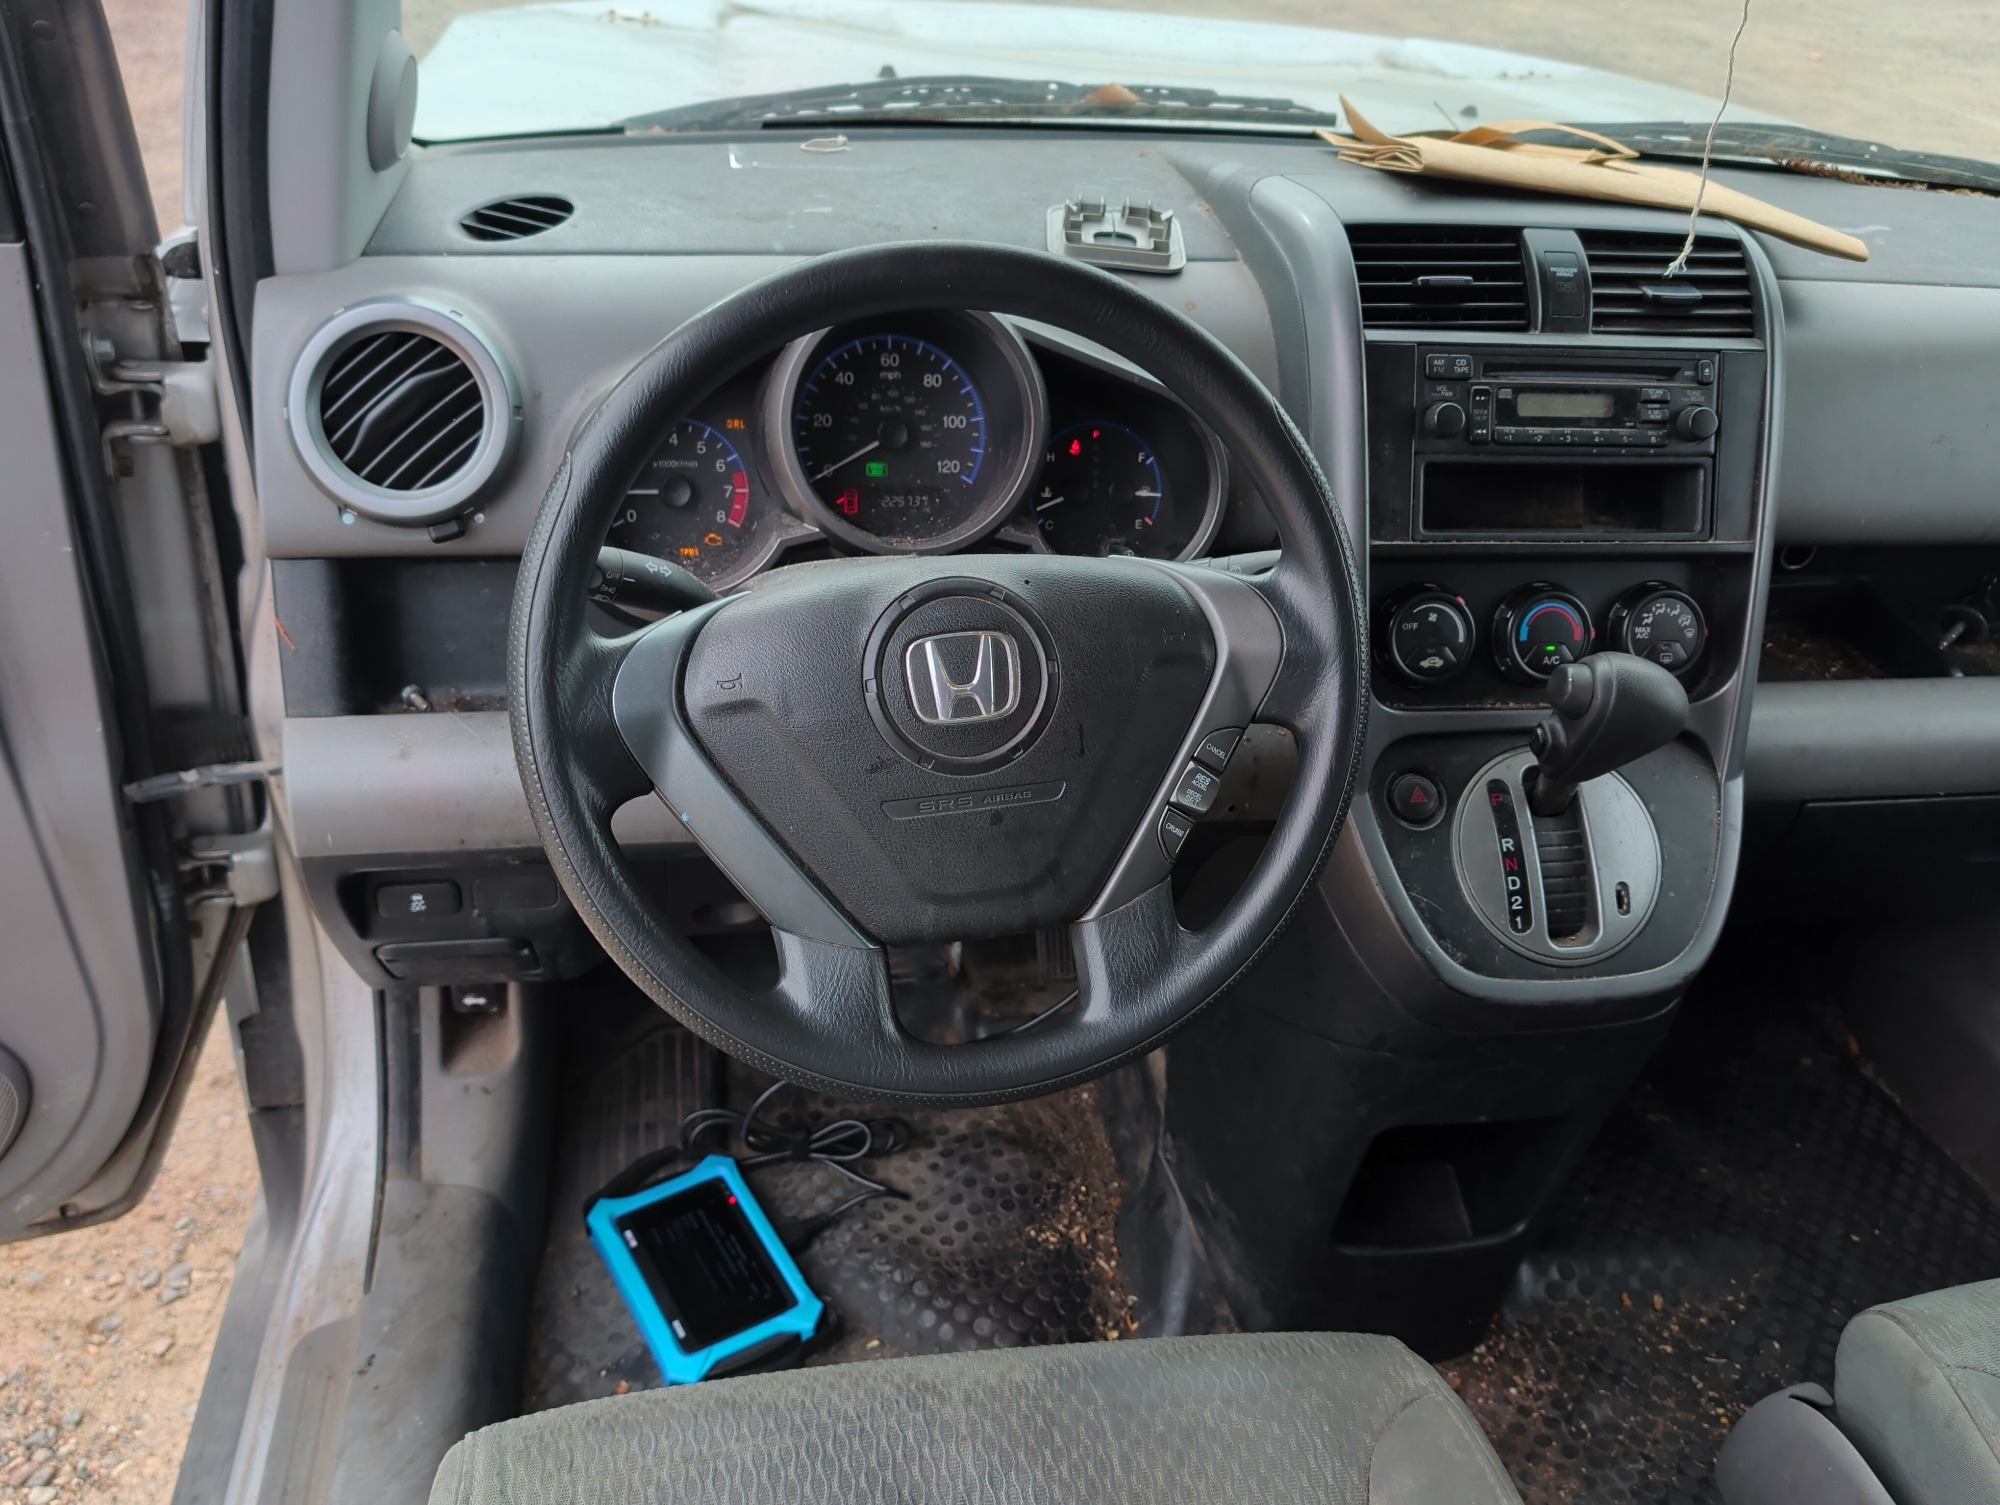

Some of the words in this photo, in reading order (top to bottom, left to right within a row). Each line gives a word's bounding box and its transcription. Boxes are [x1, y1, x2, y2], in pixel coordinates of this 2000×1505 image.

[880, 354, 899, 367] 60
[880, 371, 901, 380] mph
[1454, 366, 1469, 374] TAPE
[835, 372, 854, 385] 40
[923, 374, 942, 387] 80
[726, 419, 744, 429] DRL
[813, 415, 831, 427] 20
[943, 416, 966, 429] 100
[669, 433, 678, 445] 4
[1093, 430, 1100, 438] P
[697, 441, 706, 454] 5
[1046, 453, 1055, 462] H
[1138, 453, 1145, 462] F
[716, 460, 726, 472] 6
[937, 461, 960, 473] 120
[723, 486, 733, 498] 7
[626, 510, 637, 522] 0
[716, 511, 726, 523] 8
[1045, 520, 1054, 529] C
[1135, 519, 1142, 529] E
[1543, 656, 1560, 665] A/C
[1206, 743, 1225, 760] CANCEL
[1191, 779, 1207, 792] ACCEL
[1195, 773, 1211, 786] RES
[1185, 794, 1200, 807] SET
[1187, 788, 1202, 801] DECEL
[1491, 794, 1504, 806] P
[919, 796, 973, 813] SRS
[983, 791, 1032, 804] AIRBAG
[1165, 822, 1185, 838] CRUISE
[1501, 838, 1515, 852] R
[1505, 857, 1518, 871] N
[1507, 876, 1521, 890] D
[1511, 896, 1523, 910] 2
[1515, 917, 1523, 929] 1
